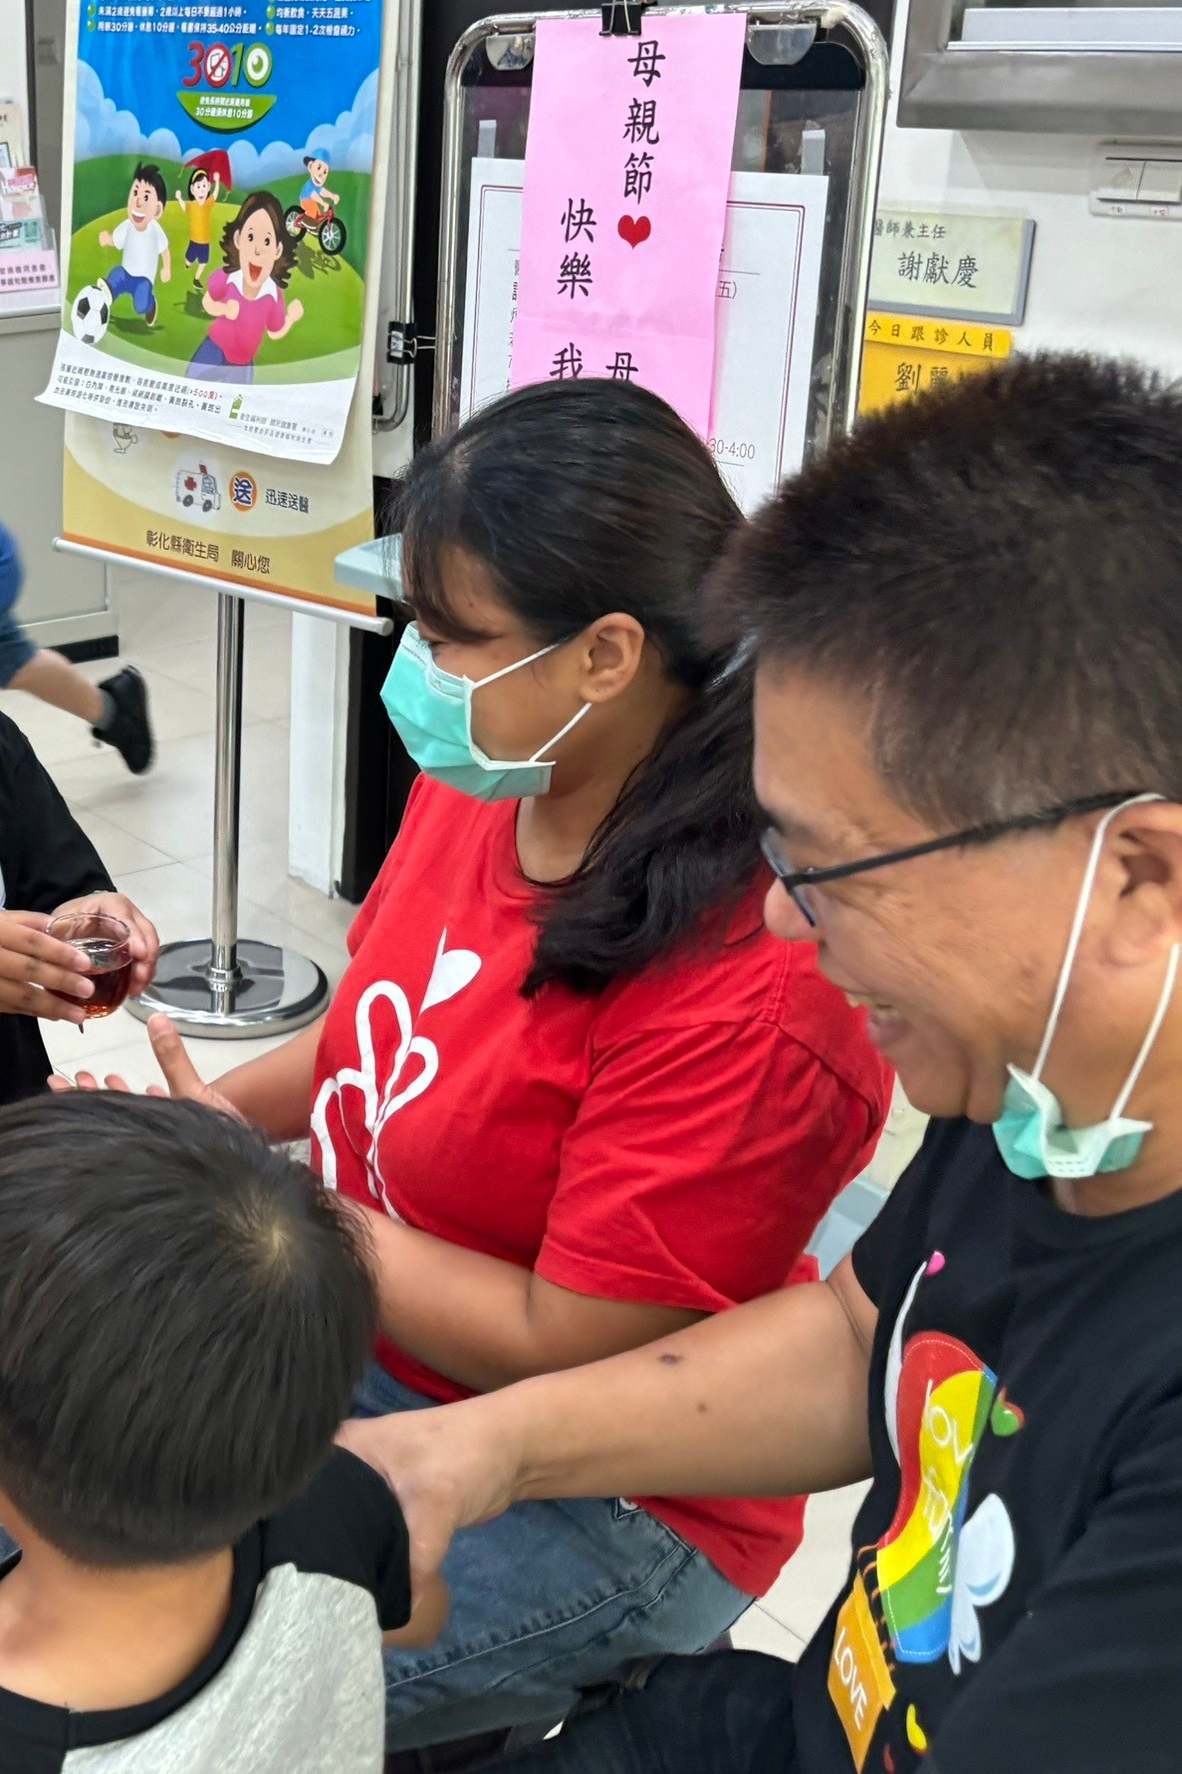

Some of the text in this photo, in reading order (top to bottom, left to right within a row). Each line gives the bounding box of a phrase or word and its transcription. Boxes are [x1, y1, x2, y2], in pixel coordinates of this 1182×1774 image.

[182, 41, 273, 89] 3010
[622, 39, 667, 206] 母親節
[556, 198, 598, 299] 快樂
[873, 218, 947, 240] 醫師兼主任
[897, 250, 979, 289] 謝獻慶
[868, 319, 994, 352] 今日跟診人員
[232, 476, 254, 506] 送
[265, 488, 310, 514] 迅速送醫
[146, 529, 271, 574] 彰化縣衛生局 關心您
[834, 1626, 868, 1731] LOVE
